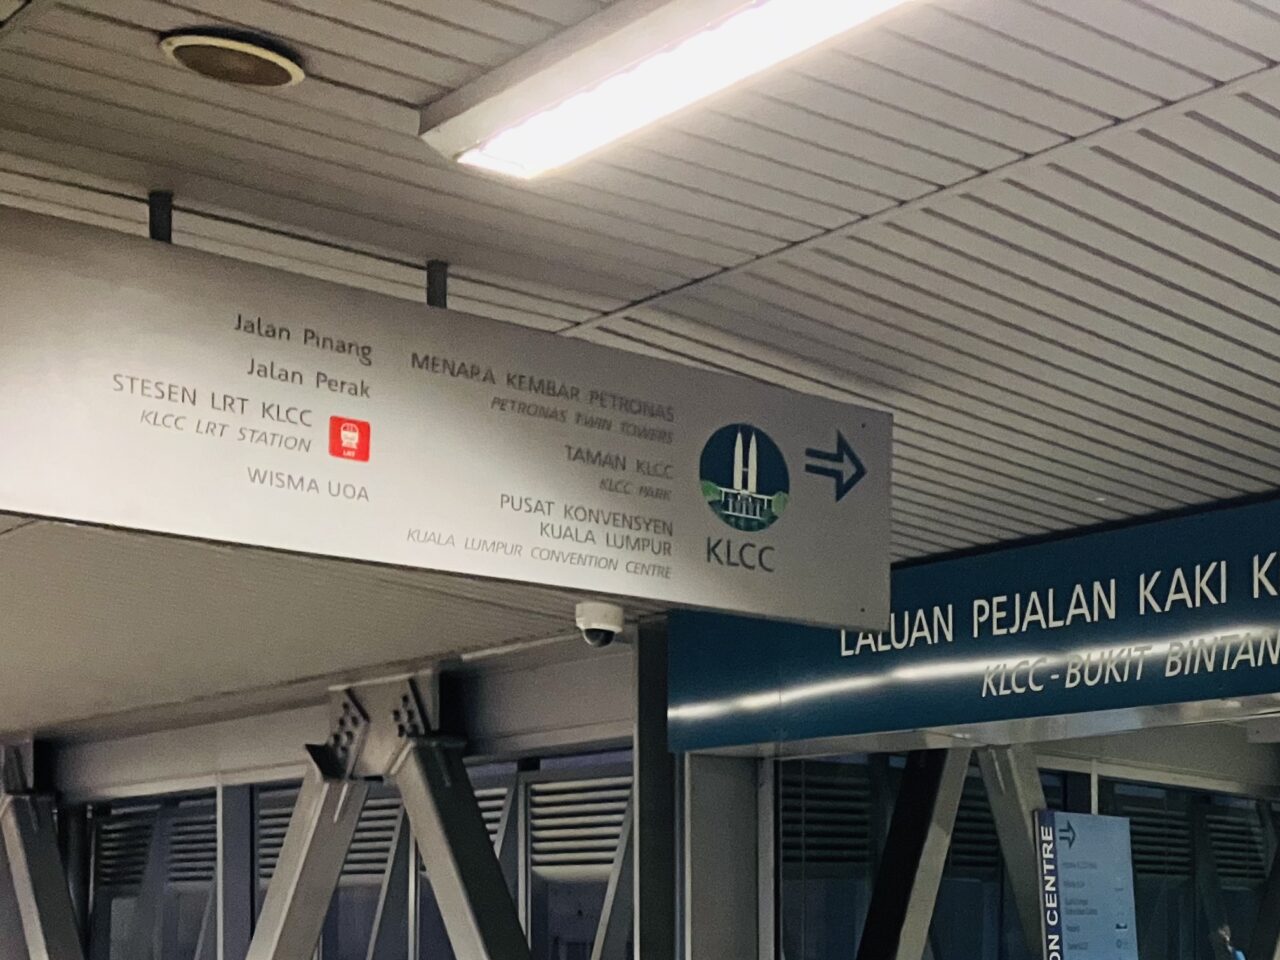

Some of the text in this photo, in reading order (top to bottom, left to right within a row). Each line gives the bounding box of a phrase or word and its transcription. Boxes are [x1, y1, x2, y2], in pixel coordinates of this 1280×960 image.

[234, 314, 372, 366] Jalan Pinang
[247, 358, 371, 399] Jalan Perak
[411, 352, 675, 422] MENARA KEMBAR PETRONAS
[113, 374, 313, 427] STESEN LRT KLCC
[491, 397, 567, 422] PETRONAS
[140, 410, 312, 452] KLCC LRT STATION
[565, 445, 674, 479] TAMAN KLCC
[248, 467, 370, 502] WISMA UOA
[600, 478, 632, 494] KLCC
[500, 494, 673, 537] PUSAT KONVENSYEN
[407, 528, 671, 579] KUALA LUMPUR CONVENTION CENTRE
[540, 522, 672, 556] KUALA LUMPUR
[706, 536, 775, 572] KLCC
[841, 604, 953, 657] LALUAN
[972, 578, 1116, 638] PEJALAN
[1139, 560, 1227, 615] KAKI
[982, 645, 1153, 697] KLCC-BUKIT
[1040, 824, 1058, 926] CENTRE
